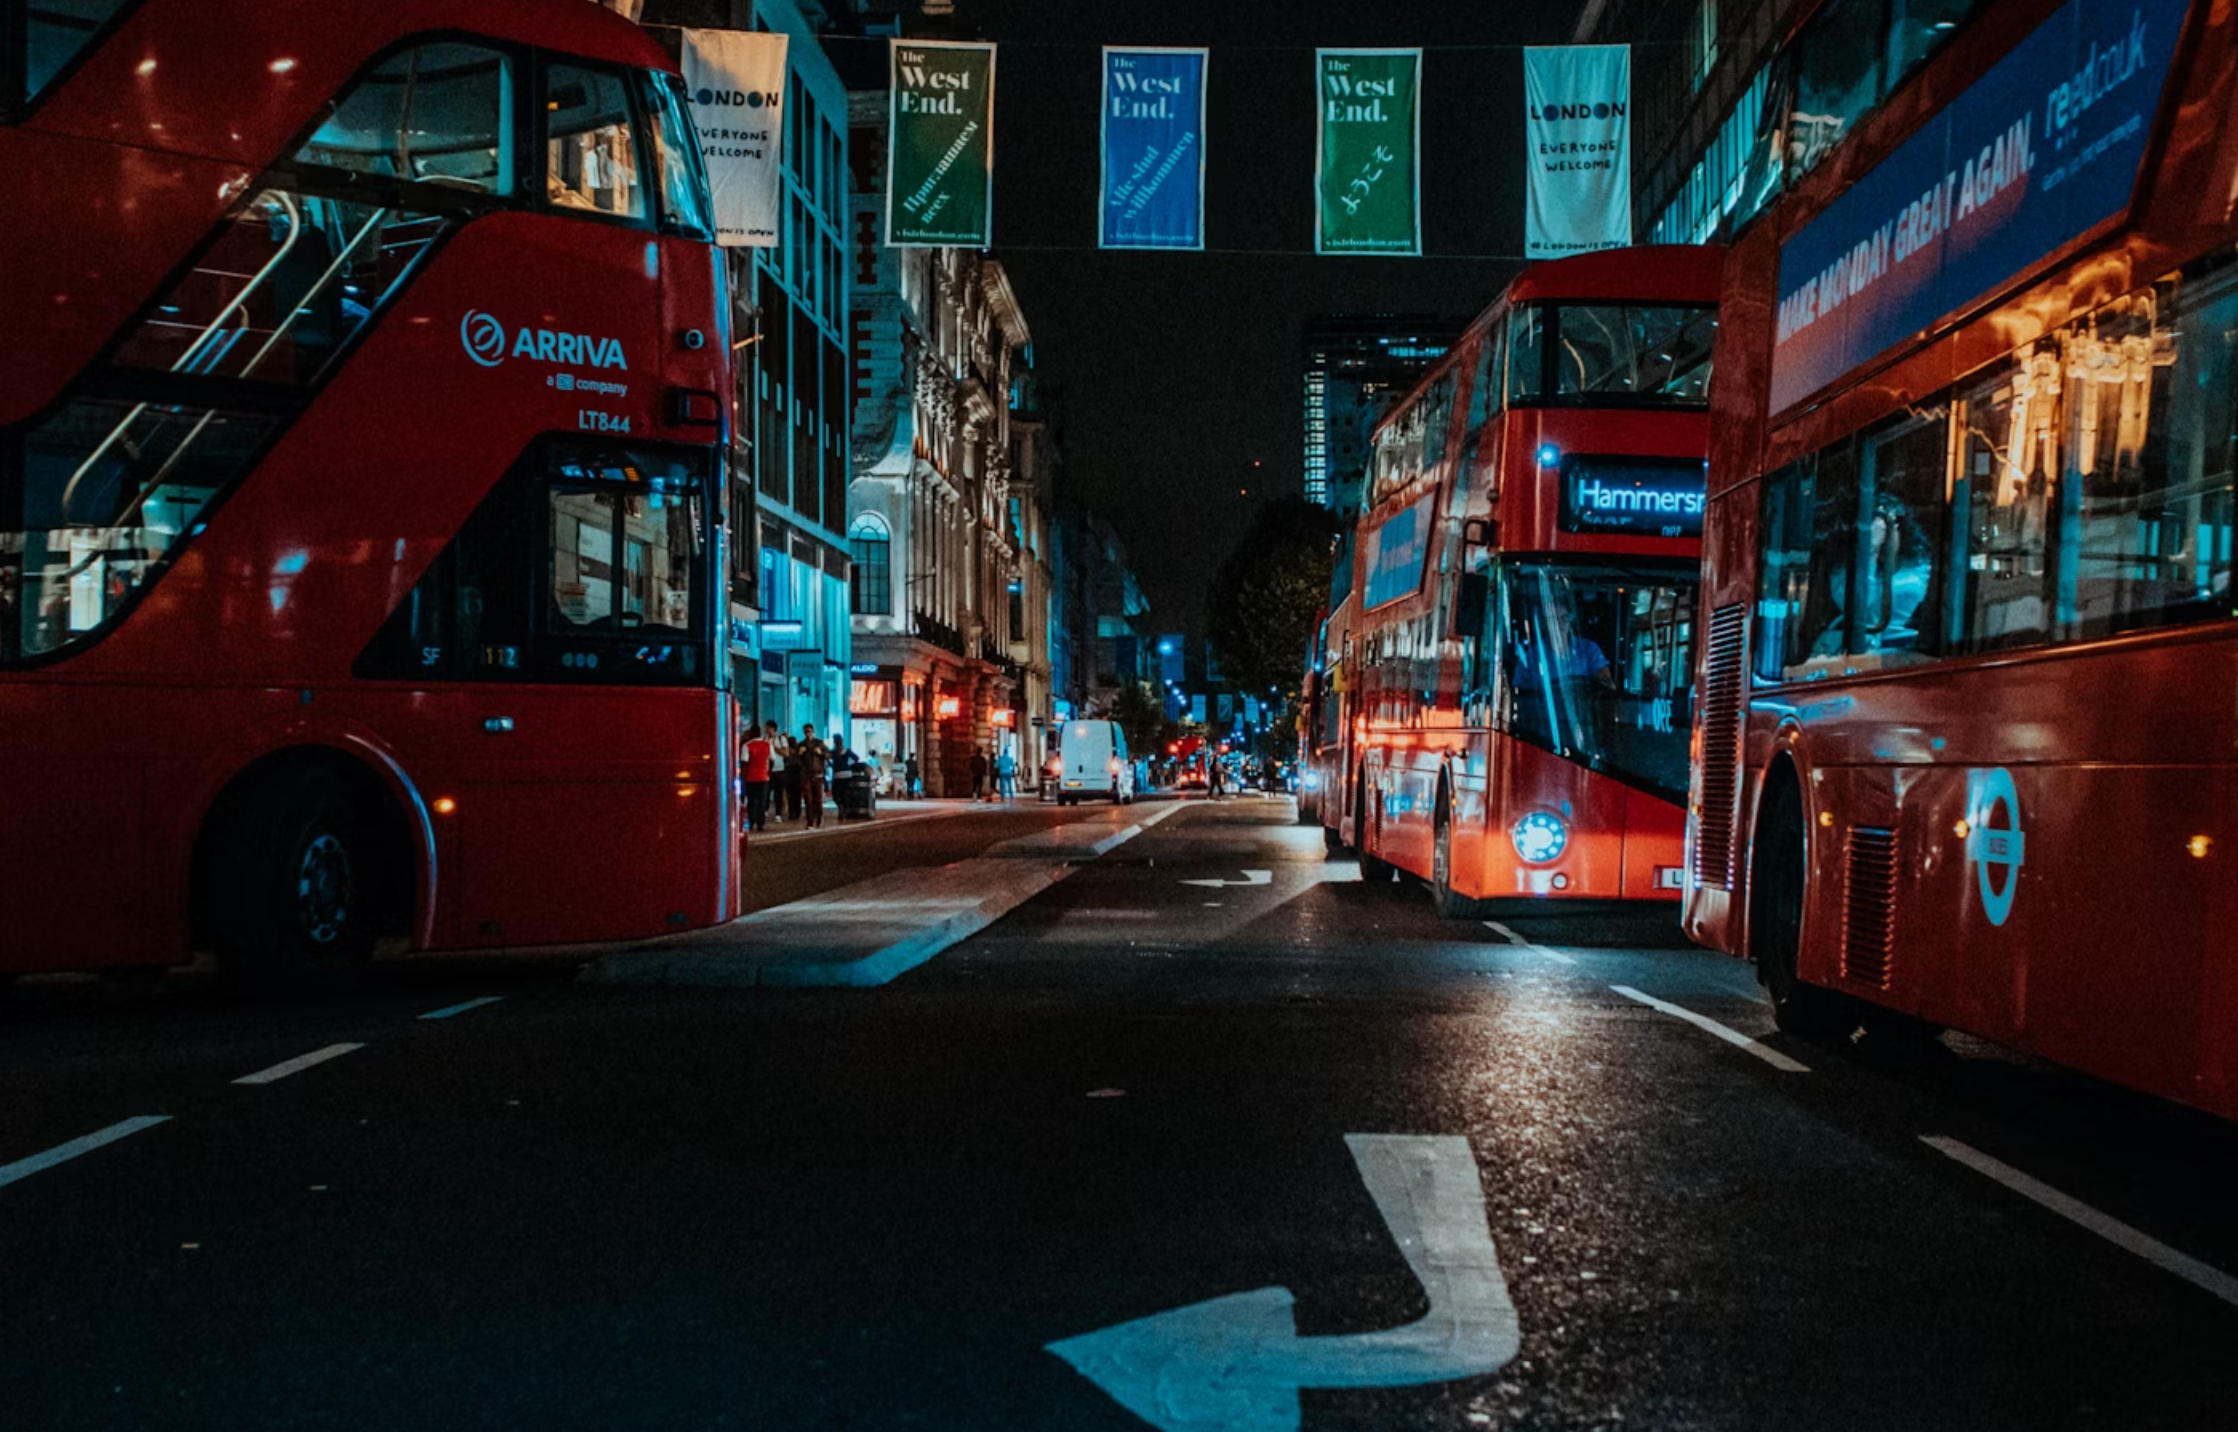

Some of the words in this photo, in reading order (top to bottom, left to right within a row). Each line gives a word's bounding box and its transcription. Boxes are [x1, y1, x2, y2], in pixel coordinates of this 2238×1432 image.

[902, 50, 925, 63] The
[1114, 57, 1137, 69] The
[1328, 59, 1351, 71] The
[902, 66, 971, 90] West
[1113, 72, 1182, 95] West
[1327, 75, 1395, 97] West
[901, 91, 963, 115] End.
[1112, 96, 1175, 119] End.
[1327, 98, 1389, 122] End.
[1530, 102, 1626, 122] LONDON
[1540, 140, 1617, 154] EVERYONE
[1545, 159, 1612, 172] WELCOME
[1776, 276, 1818, 346] MAKE
[1818, 218, 1894, 318] MONDAY
[1895, 170, 1957, 263] GREAT
[1958, 110, 2036, 221] AGAIN.
[511, 328, 628, 371] ARRIVA
[546, 375, 554, 386] a
[576, 378, 628, 397] company
[578, 409, 631, 432] LT844
[422, 647, 441, 665] SF
[850, 664, 878, 673] ALDO
